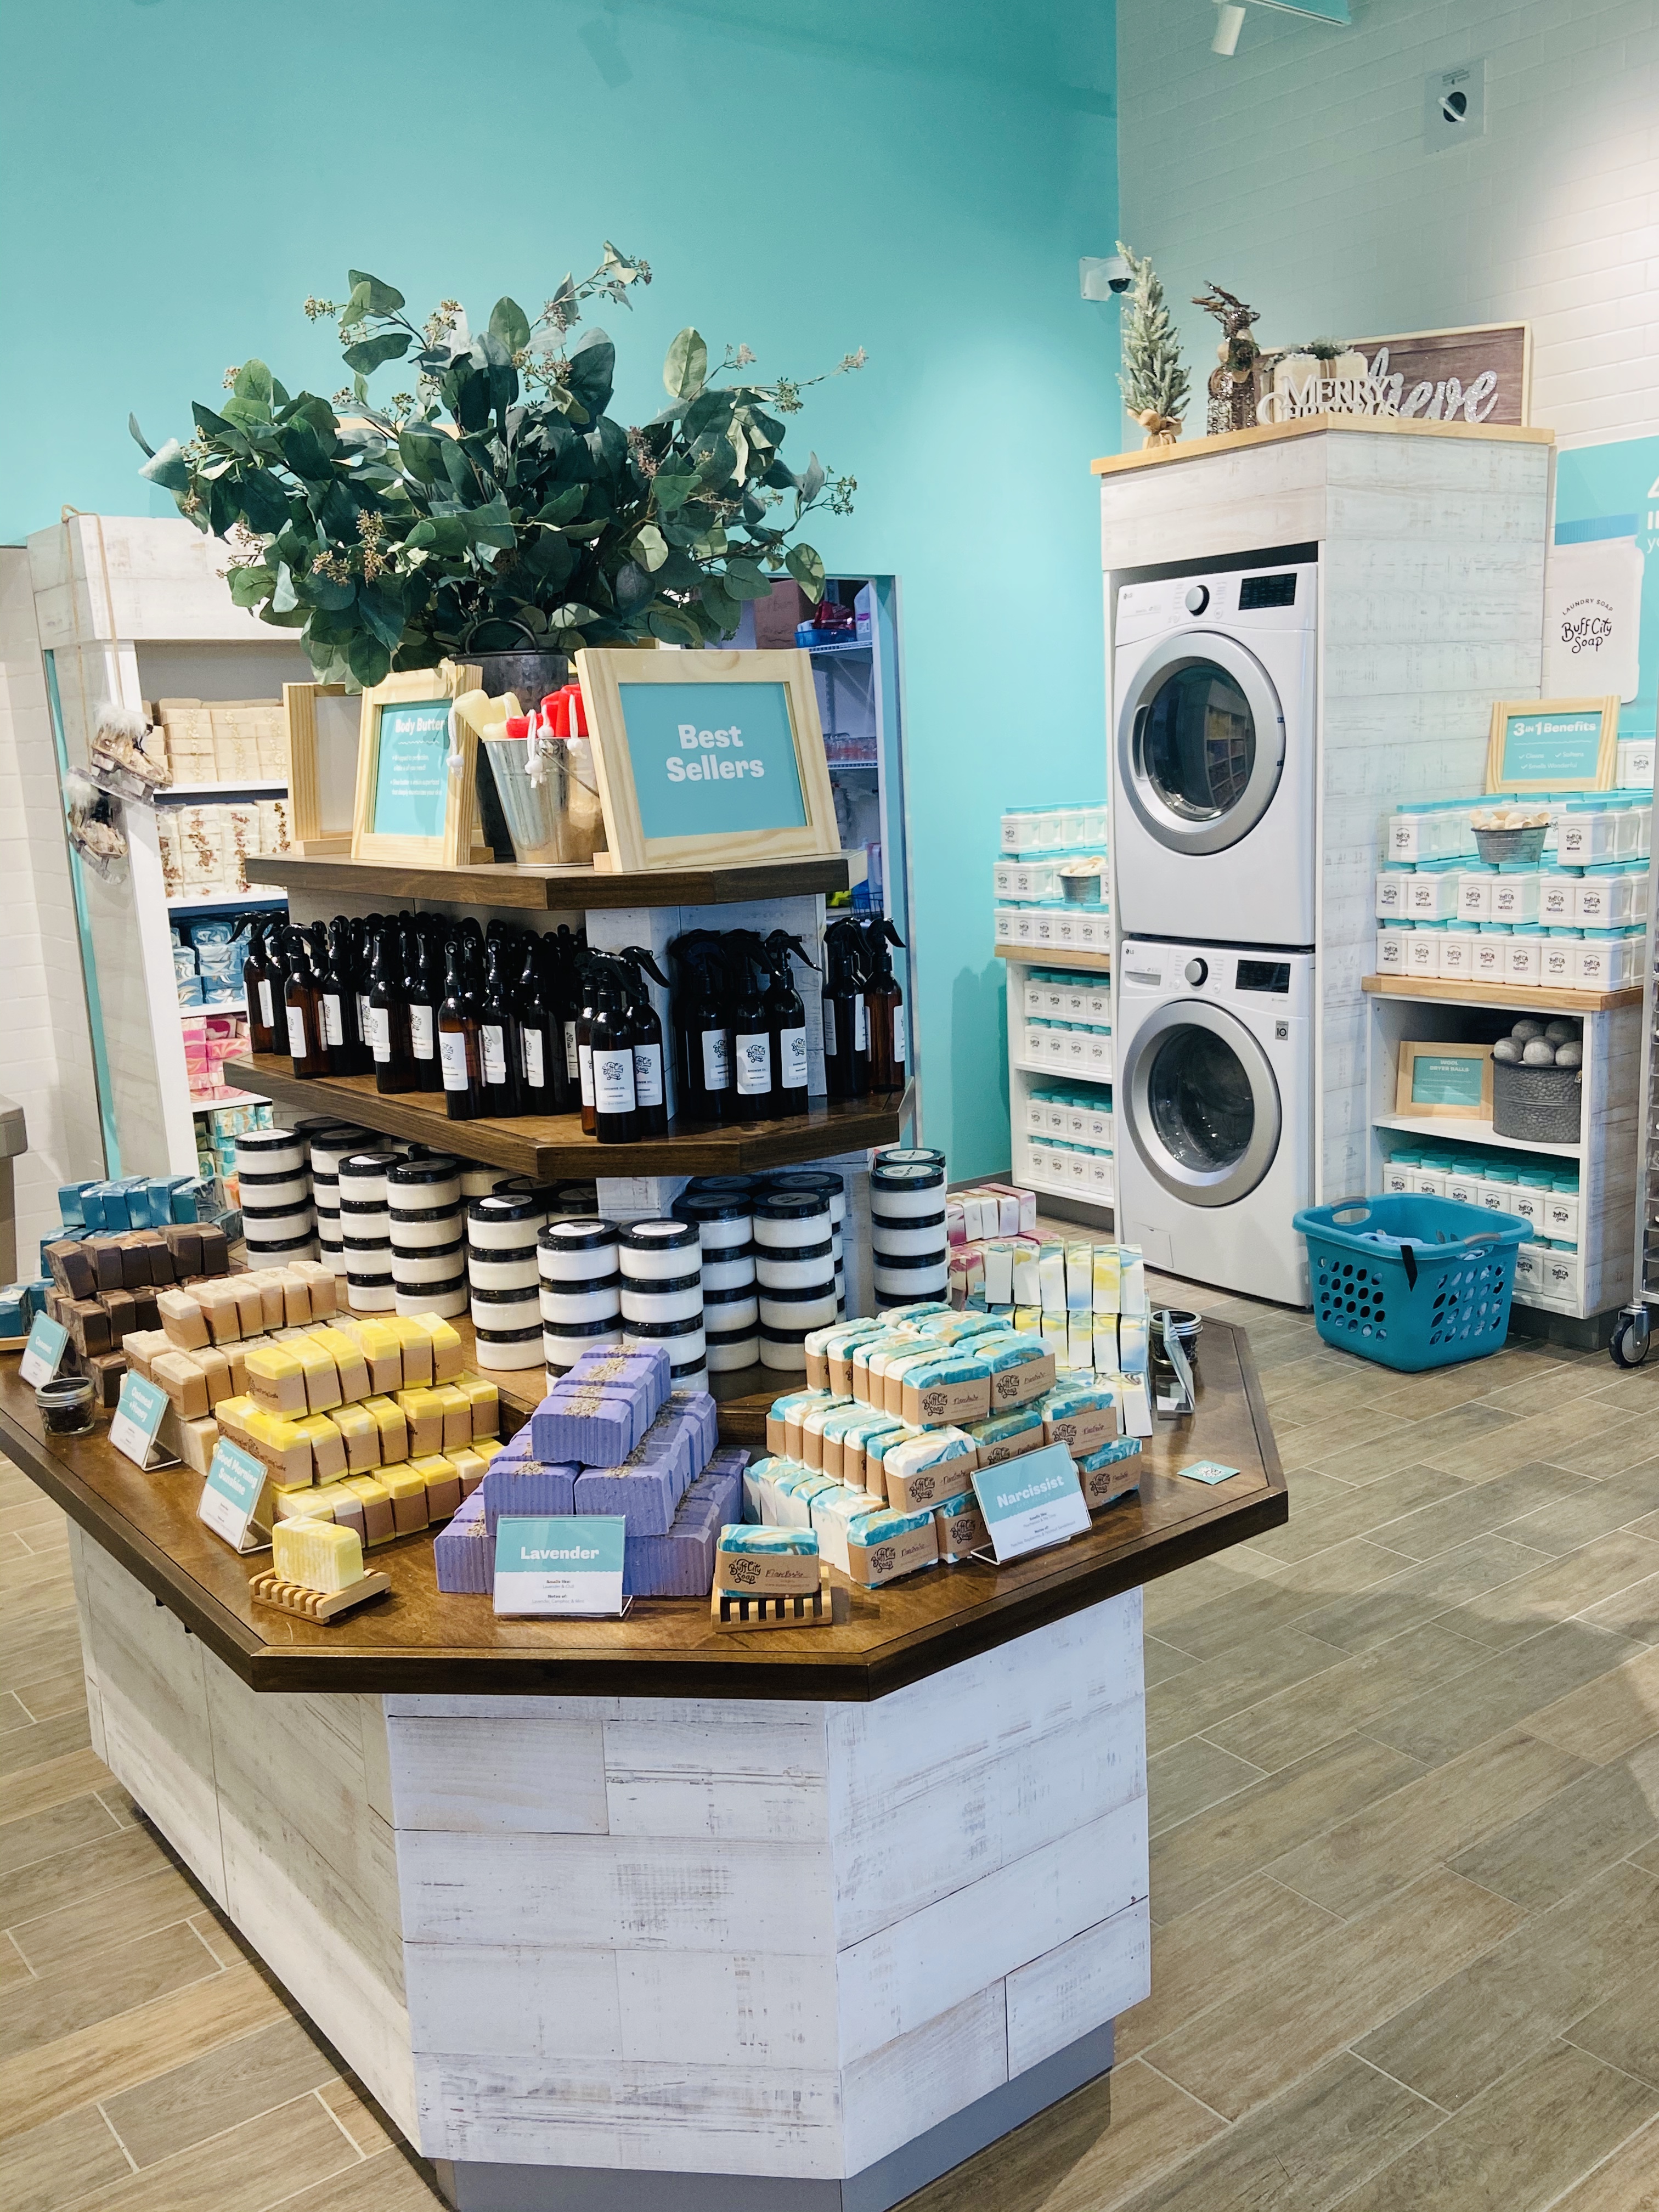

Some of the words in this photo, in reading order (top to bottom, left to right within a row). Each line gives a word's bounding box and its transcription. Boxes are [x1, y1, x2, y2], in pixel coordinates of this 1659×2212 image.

[1281, 374, 1391, 407] MERRY
[1562, 598, 1594, 615] LAUNDRY
[1596, 599, 1613, 611] SOAP
[1561, 617, 1591, 642] Buff
[1592, 618, 1612, 636] City
[1572, 636, 1603, 653] Soap
[395, 718, 415, 736] Body
[416, 718, 445, 732] Butter
[1513, 723, 1525, 736] 3
[1534, 721, 1543, 735] 1
[1543, 720, 1596, 733] Benefits
[678, 724, 744, 749] Best
[665, 754, 765, 782] Sellers
[131, 1386, 154, 1409] Oatmeal
[922, 1394, 937, 1410] Buff
[928, 1406, 945, 1417] Soap
[217, 1448, 233, 1468] Good
[232, 1459, 258, 1489] Morning
[218, 1467, 246, 1496] Sunshine
[909, 1479, 924, 1497] Buff
[916, 1489, 933, 1503] Soap
[996, 1475, 1064, 1508] Narcissist
[521, 1545, 600, 1560] Lavender
[729, 1560, 748, 1576] Buff
[747, 1561, 761, 1576] City
[734, 1573, 757, 1585] Soap
